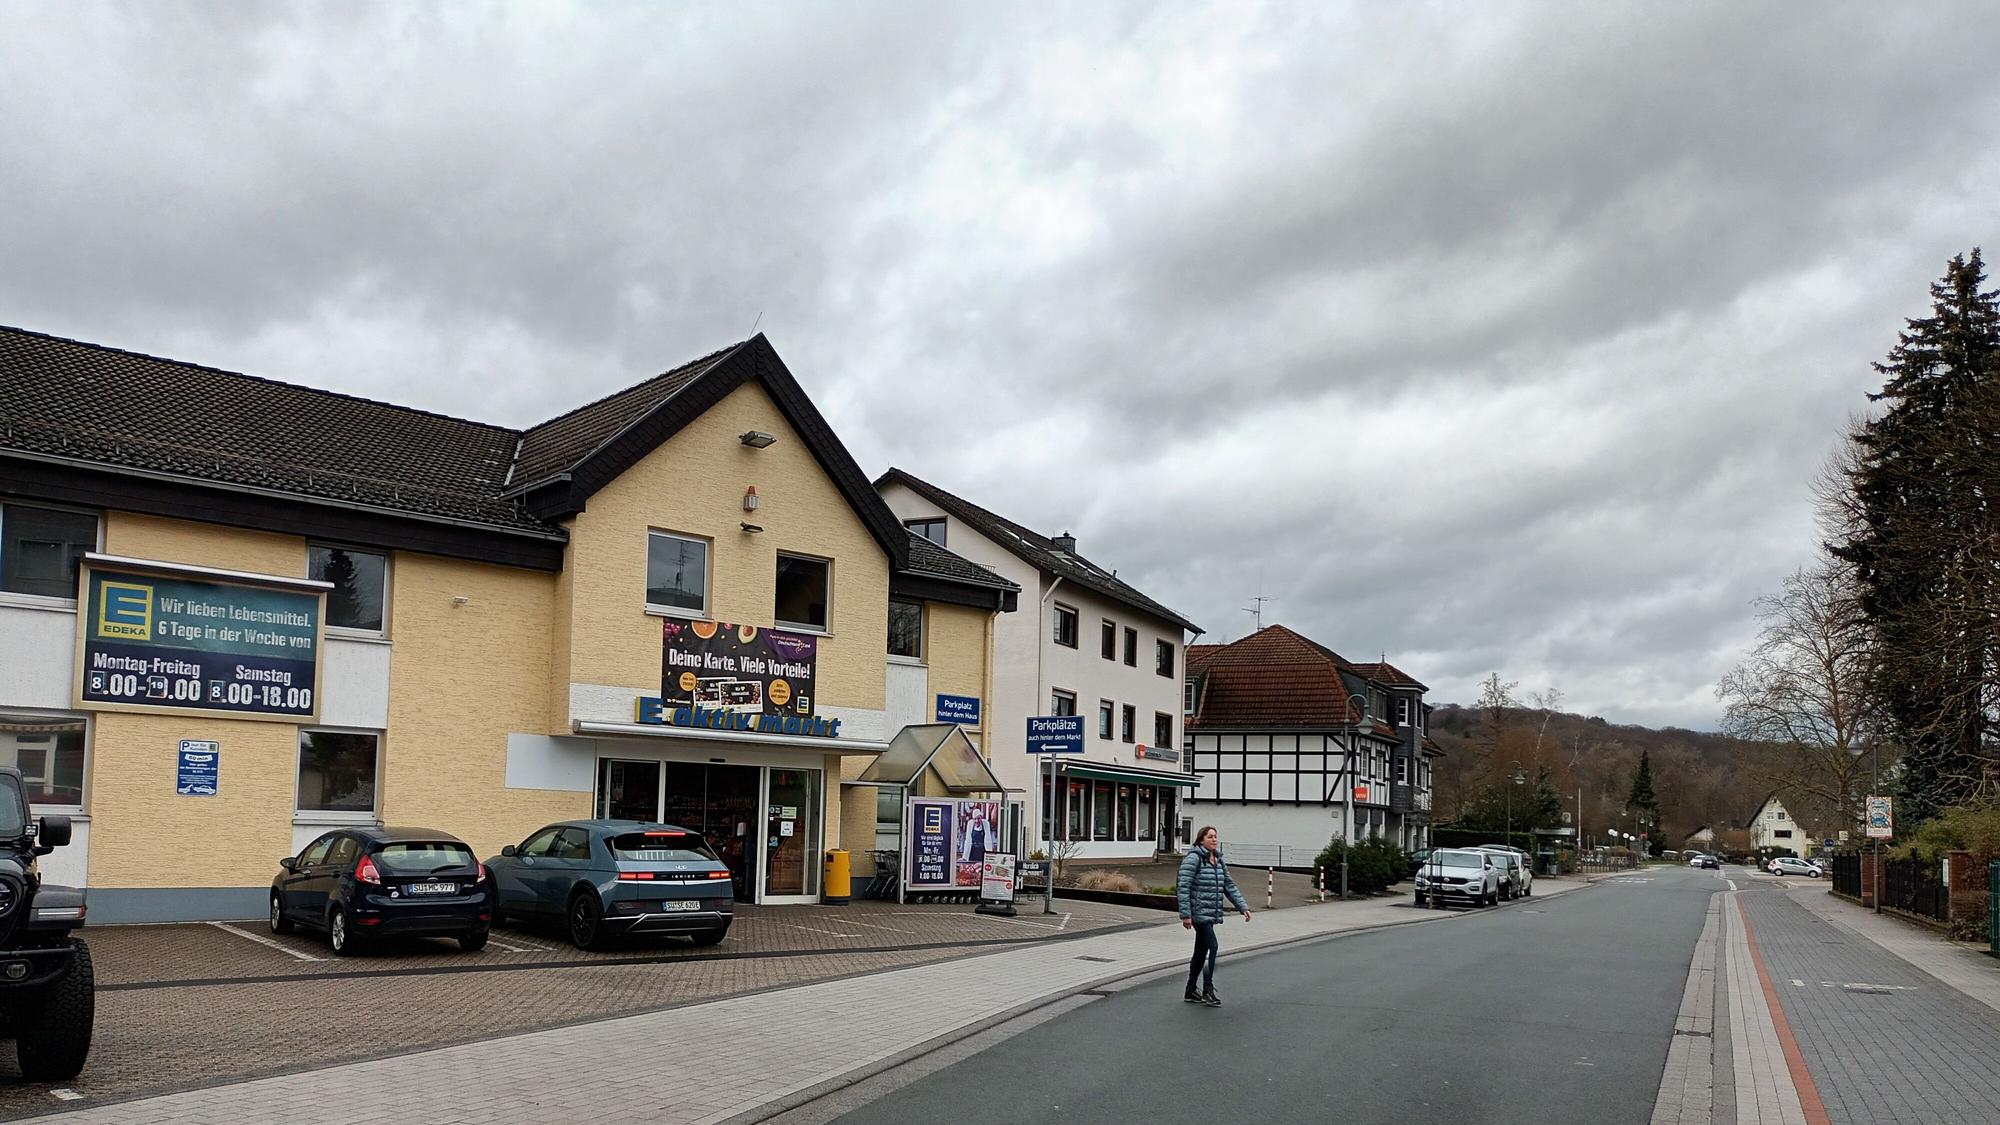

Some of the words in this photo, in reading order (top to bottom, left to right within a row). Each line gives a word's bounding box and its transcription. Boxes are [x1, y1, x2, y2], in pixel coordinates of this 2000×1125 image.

[161, 597, 184, 614] Wir
[187, 600, 225, 618] lieben
[229, 605, 311, 627] Lebensmittel.
[104, 625, 146, 636] EDEKA
[158, 621, 167, 635] 6
[170, 621, 201, 640] Tage
[205, 625, 216, 639] in
[220, 627, 241, 642] der
[244, 629, 286, 646] Woche
[289, 637, 311, 649] von
[94, 652, 200, 679] Montag-Freitag
[236, 665, 292, 686] Samstag
[669, 648, 701, 667] Deine
[704, 652, 737, 671] Karte.
[740, 656, 765, 674] Viele
[768, 659, 810, 679] Vorteile!
[212, 683, 311, 708] 8.00-18.00
[944, 700, 972, 710] Parkplatz
[635, 696, 662, 724] E
[670, 704, 752, 731] aktiv
[754, 715, 841, 738] markt
[1032, 719, 1077, 733] Parkplätze
[440, 883, 453, 891] 977
